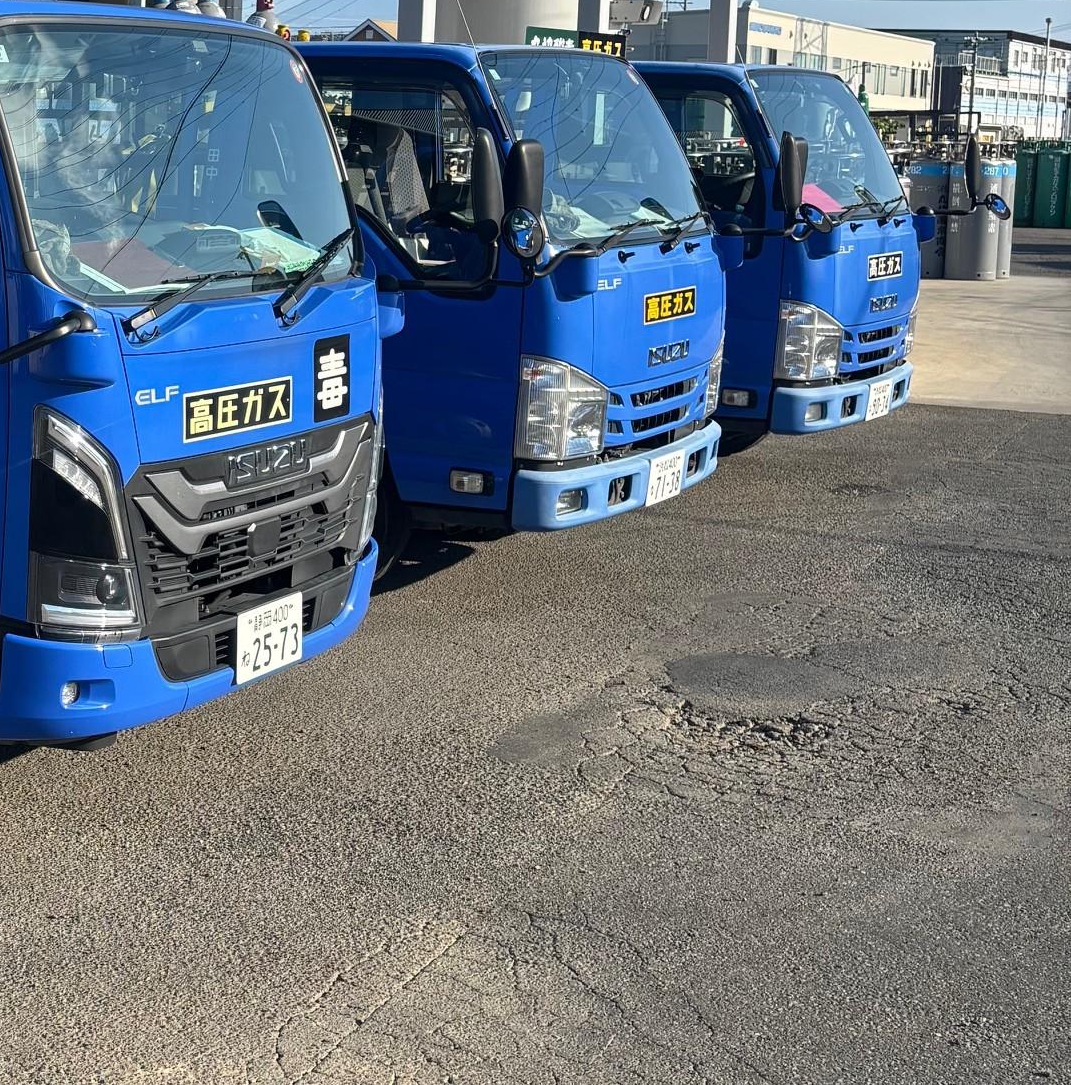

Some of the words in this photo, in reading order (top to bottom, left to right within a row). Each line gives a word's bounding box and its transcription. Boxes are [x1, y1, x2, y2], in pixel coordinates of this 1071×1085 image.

[870, 256, 901, 278] 高圧ガス
[597, 278, 622, 291] ELF
[647, 291, 694, 321] 高圧ガス
[647, 339, 690, 368] ISUZU
[316, 347, 349, 411] 毒
[135, 385, 180, 406] ELF
[189, 384, 287, 435] 高圧ガス
[228, 439, 306, 488] ISUZU
[655, 469, 681, 500] 71-38
[253, 623, 299, 672] 25-73
